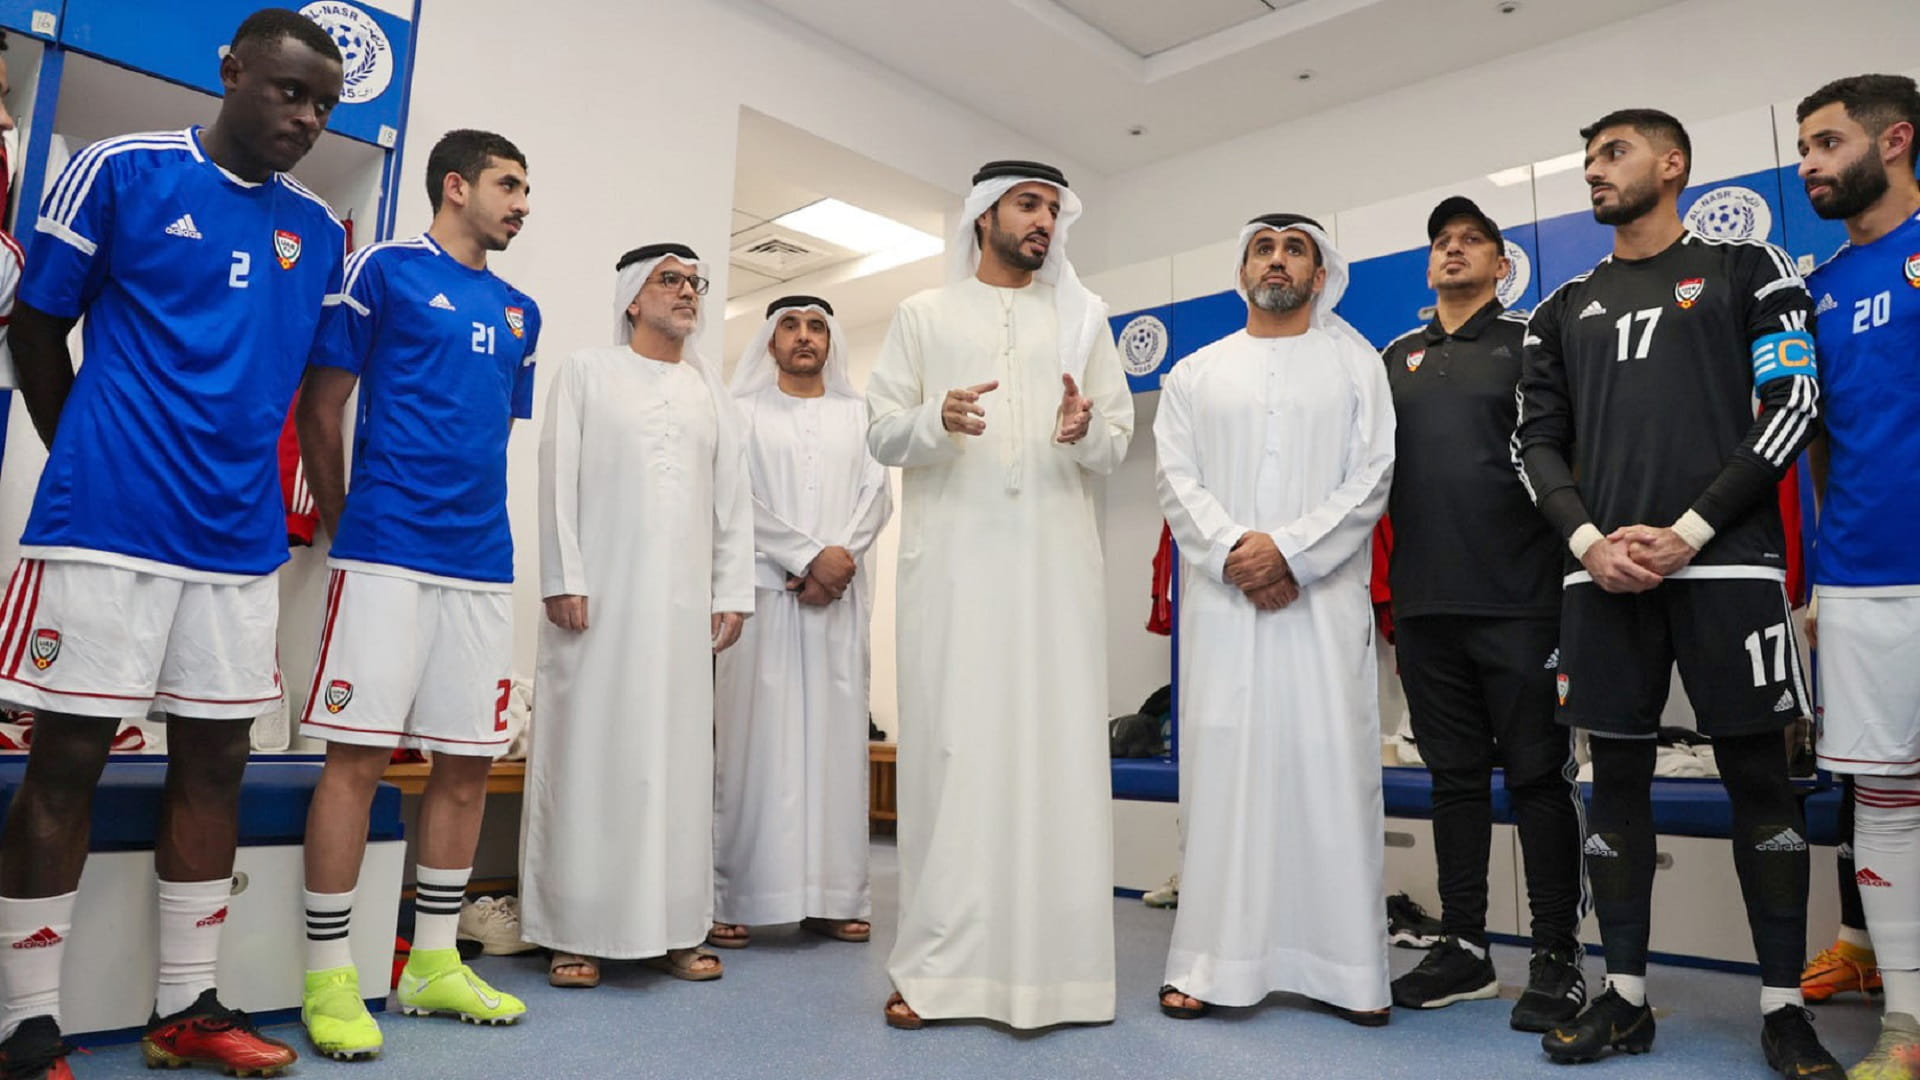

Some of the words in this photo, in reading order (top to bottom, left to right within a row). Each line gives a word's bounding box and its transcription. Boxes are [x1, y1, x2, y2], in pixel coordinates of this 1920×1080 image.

[228, 250, 251, 289] 2
[1852, 290, 1891, 335] 20
[471, 321, 496, 356] 21
[1615, 306, 1664, 362] 17
[1778, 338, 1810, 367] C
[1744, 622, 1787, 688] 17
